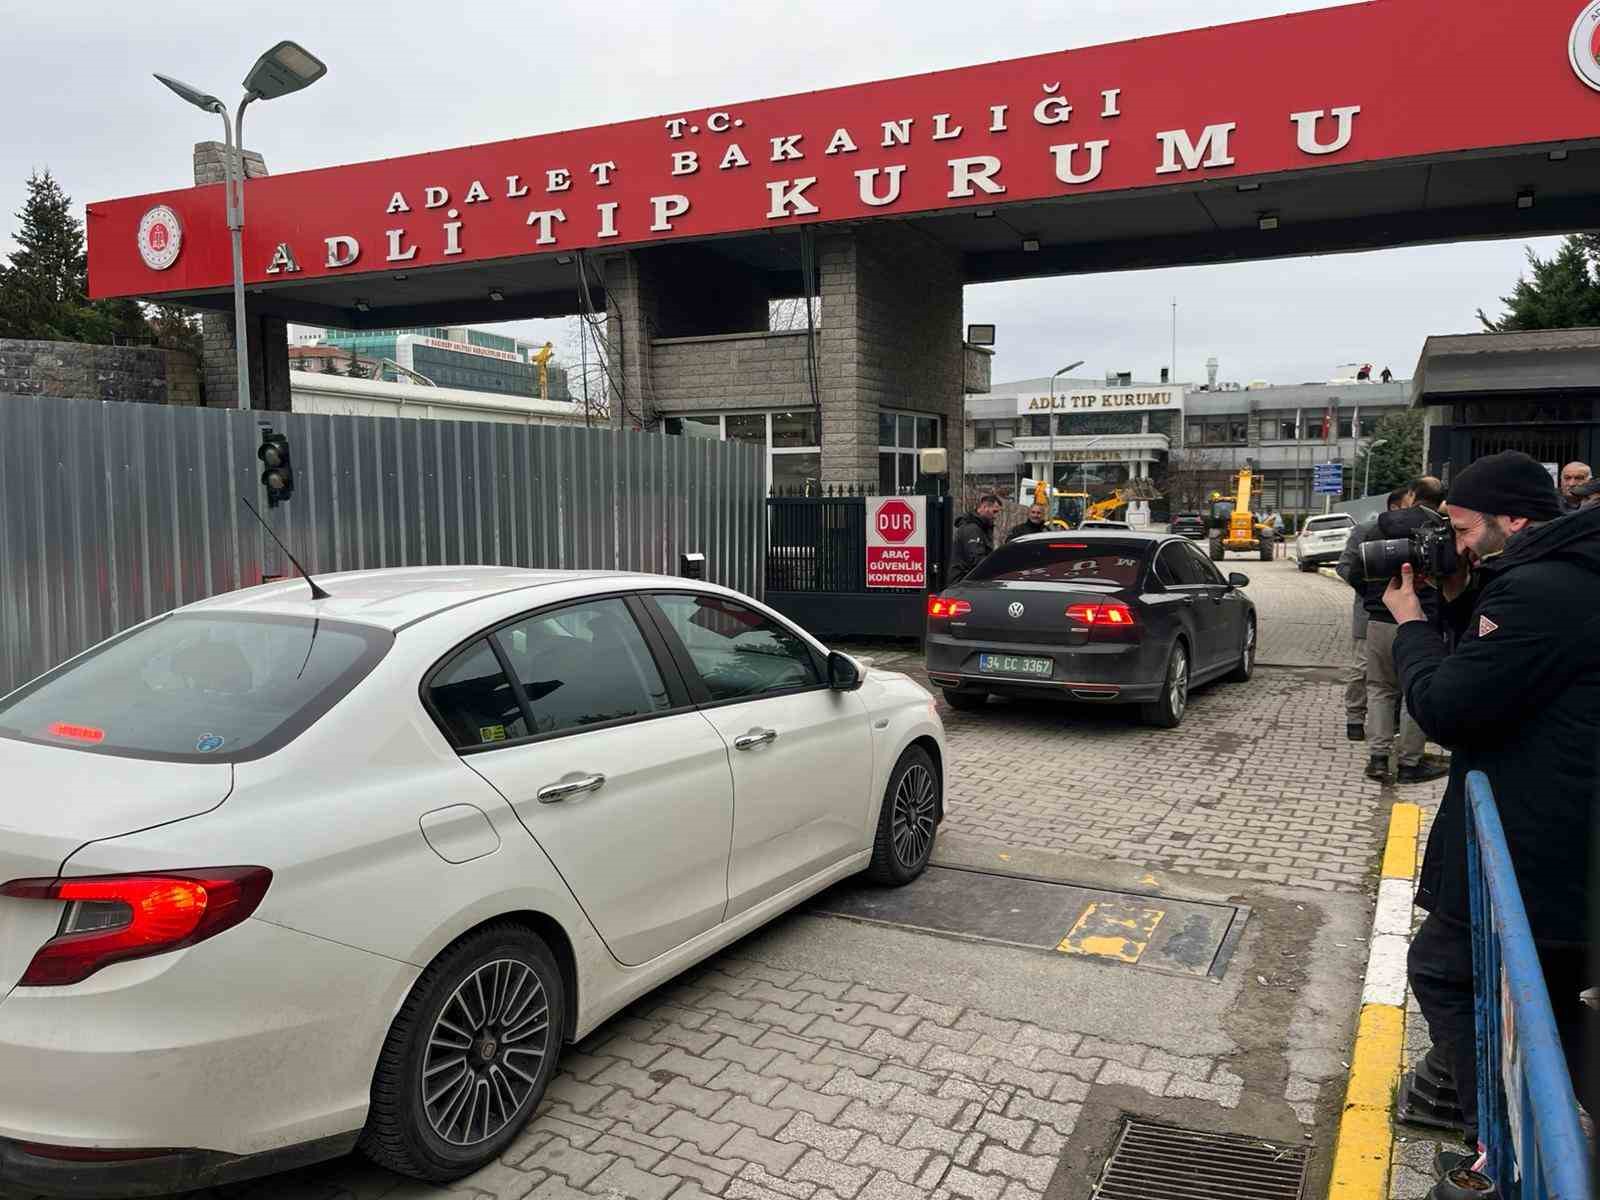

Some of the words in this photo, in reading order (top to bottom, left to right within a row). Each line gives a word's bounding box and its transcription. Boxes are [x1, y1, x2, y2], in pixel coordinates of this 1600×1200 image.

[664, 112, 743, 138] T.C.
[386, 160, 616, 213] ADALET
[671, 82, 1121, 175] BAKANLIĞI
[266, 209, 462, 274] ADLİ
[526, 194, 690, 244] TIP
[766, 105, 1361, 218] KURUMU
[1028, 394, 1065, 409] ADLİ
[1071, 395, 1096, 408] TIP
[1101, 392, 1171, 407] KURUMU
[880, 514, 912, 530] DUR
[881, 550, 910, 560] ARAÇ
[870, 561, 923, 571] GÜVENLİK
[868, 573, 923, 582] KONTROLÜ
[987, 656, 1000, 669] 34
[1004, 657, 1018, 670] CC
[1023, 659, 1050, 672] 3367
